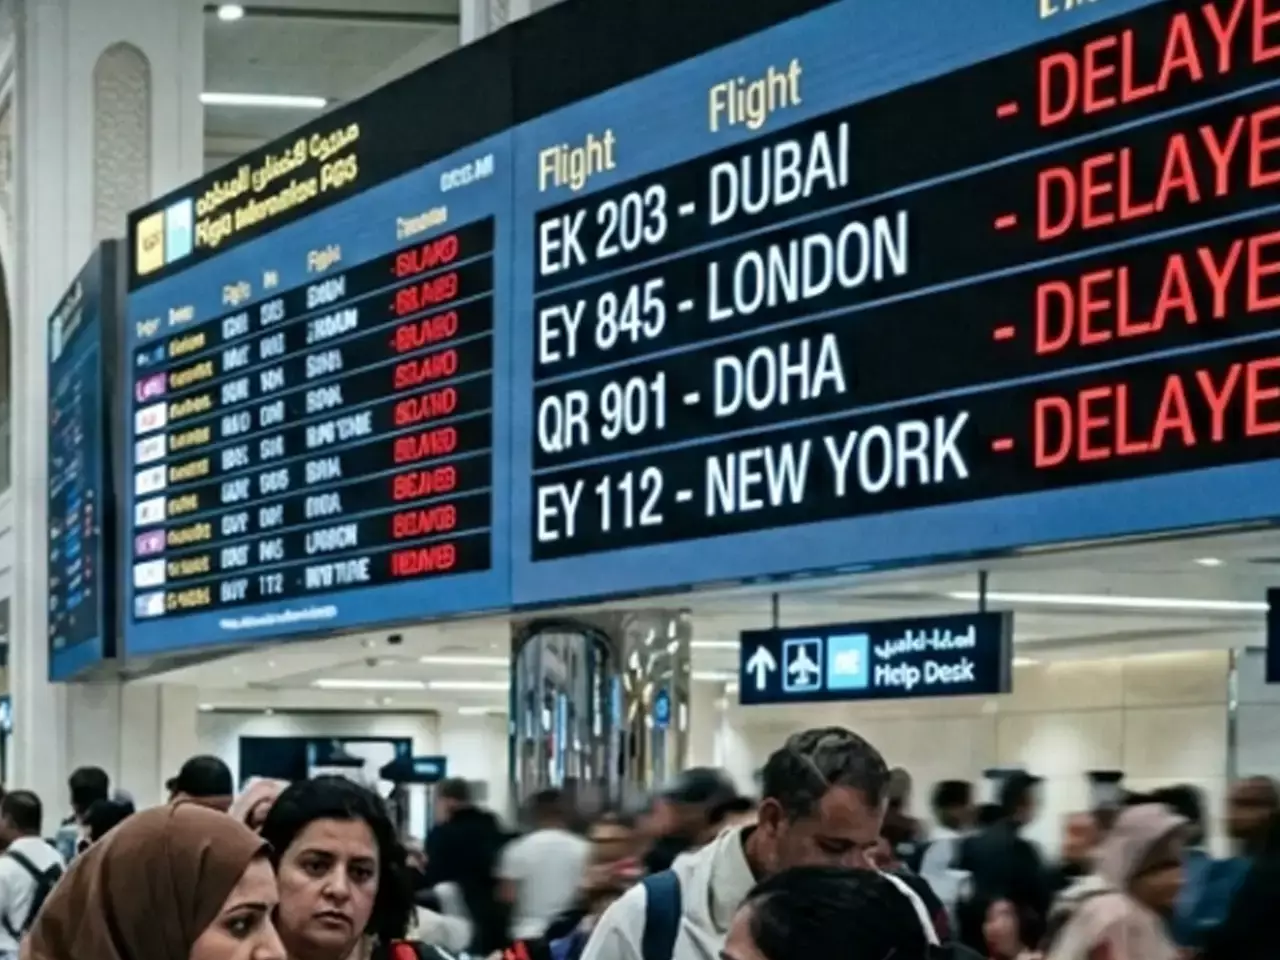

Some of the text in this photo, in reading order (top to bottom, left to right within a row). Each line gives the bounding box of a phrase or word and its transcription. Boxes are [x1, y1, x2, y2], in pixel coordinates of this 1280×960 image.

[709, 59, 802, 133] Flight
[539, 129, 616, 192] Flight
[539, 209, 587, 275] EK
[596, 184, 667, 258] 203
[710, 122, 848, 225] DUBAI
[539, 299, 587, 364] EY
[595, 278, 665, 349] 845
[709, 211, 908, 321] LONDON
[538, 390, 589, 453] QR
[600, 371, 666, 440] 901
[715, 333, 846, 416] DOHA
[538, 480, 584, 541] EY
[595, 466, 664, 532] 112
[706, 439, 811, 517] NEW
[824, 411, 969, 497] YORK
[874, 661, 921, 690] Help
[924, 656, 975, 684] Desk
